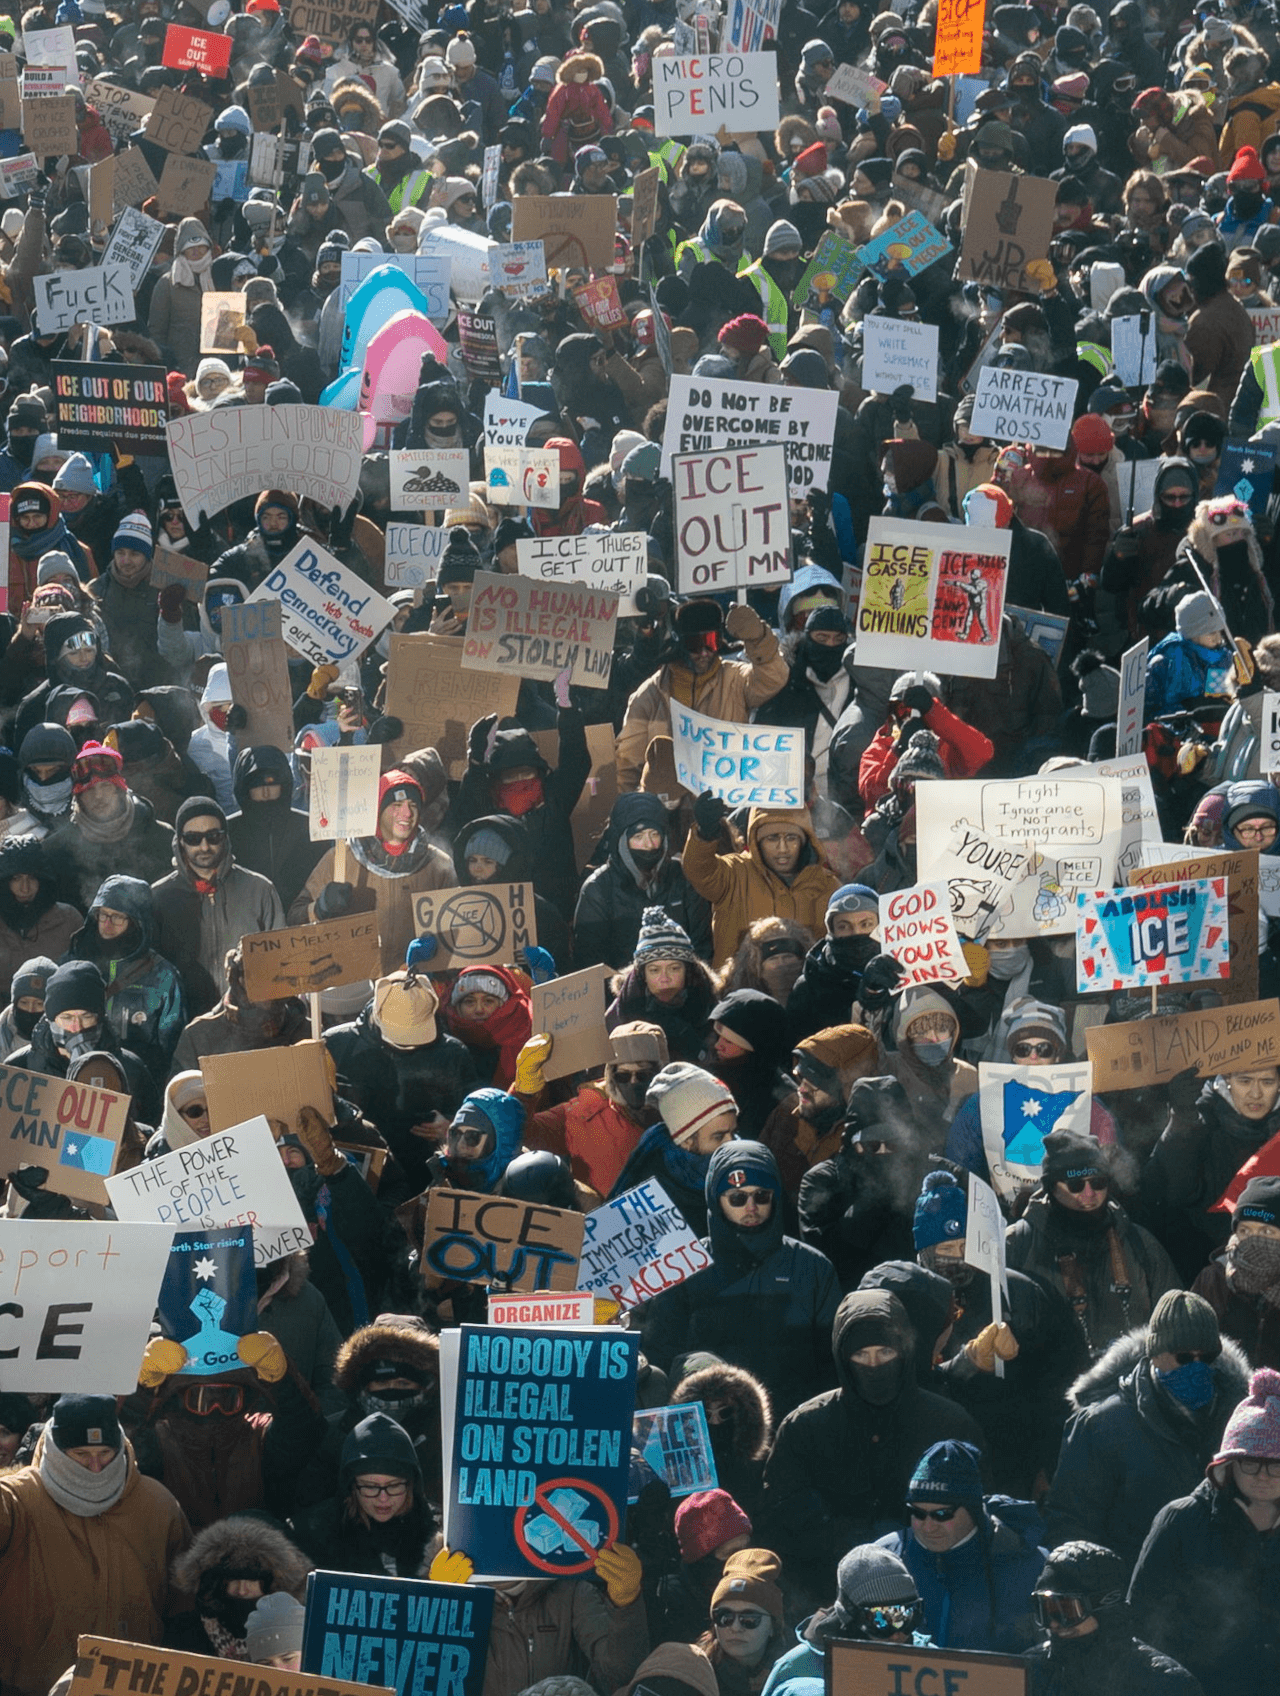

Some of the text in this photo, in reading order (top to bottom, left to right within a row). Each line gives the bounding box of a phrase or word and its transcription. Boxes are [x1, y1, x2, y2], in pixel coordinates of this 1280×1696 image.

[187, 49, 207, 60] OUT
[191, 36, 207, 48] ICE
[663, 57, 744, 82] MICRO
[669, 80, 759, 117] PENIS
[458, 313, 495, 331] ICE OUT
[57, 375, 164, 402] ICE OUT OF OUR
[988, 371, 1063, 398] ARREST
[689, 389, 792, 412] DO NOT BE
[978, 393, 1067, 420] JONATHAN
[59, 403, 167, 428] NEIGHBORHOODS
[683, 415, 809, 437] OVERCOME BY
[995, 417, 1041, 440] ROSS
[60, 427, 167, 442] freedom requires due process
[486, 431, 526, 447] YOUR
[180, 444, 354, 490] RENEE GOOD
[678, 453, 763, 500] ICE
[680, 503, 782, 556] OUT
[872, 542, 929, 562] ICE
[693, 549, 792, 584] OF MN
[867, 561, 929, 577] GASSES
[476, 585, 618, 623] NO HUMAN
[465, 635, 610, 679] ON STOLEN LAND
[679, 714, 794, 752] JUSTICE
[702, 751, 760, 781] FOR
[1018, 782, 1059, 800] Fight
[998, 801, 1084, 819] Ignorance
[1063, 861, 1095, 871] MELT
[1068, 872, 1095, 882] ICE
[461, 908, 479, 920] ICE
[888, 890, 937, 920] GOD
[249, 925, 374, 952] MN MELTS ICE
[884, 917, 950, 945] KNOWS
[543, 986, 588, 1011] Defend
[56, 1084, 118, 1134] OUT
[170, 1165, 230, 1199] OF THE
[1066, 1165, 1098, 1179] Wedge
[157, 1175, 246, 1223] PEOPLE
[610, 1185, 666, 1226] THE
[435, 1191, 562, 1250] ICE
[1243, 1208, 1276, 1222] Wedge
[582, 1203, 688, 1276] IMMIGRANTS
[426, 1233, 577, 1291] OUT
[494, 1304, 581, 1323] ORGANIZE
[464, 1380, 574, 1421] ILLEGAL
[461, 1425, 622, 1467] ON STOLEN
[326, 1587, 474, 1638] HATE WILL
[88, 1646, 169, 1695] "THE
[321, 1632, 468, 1696] NEVER
[888, 1663, 968, 1696] ICE
